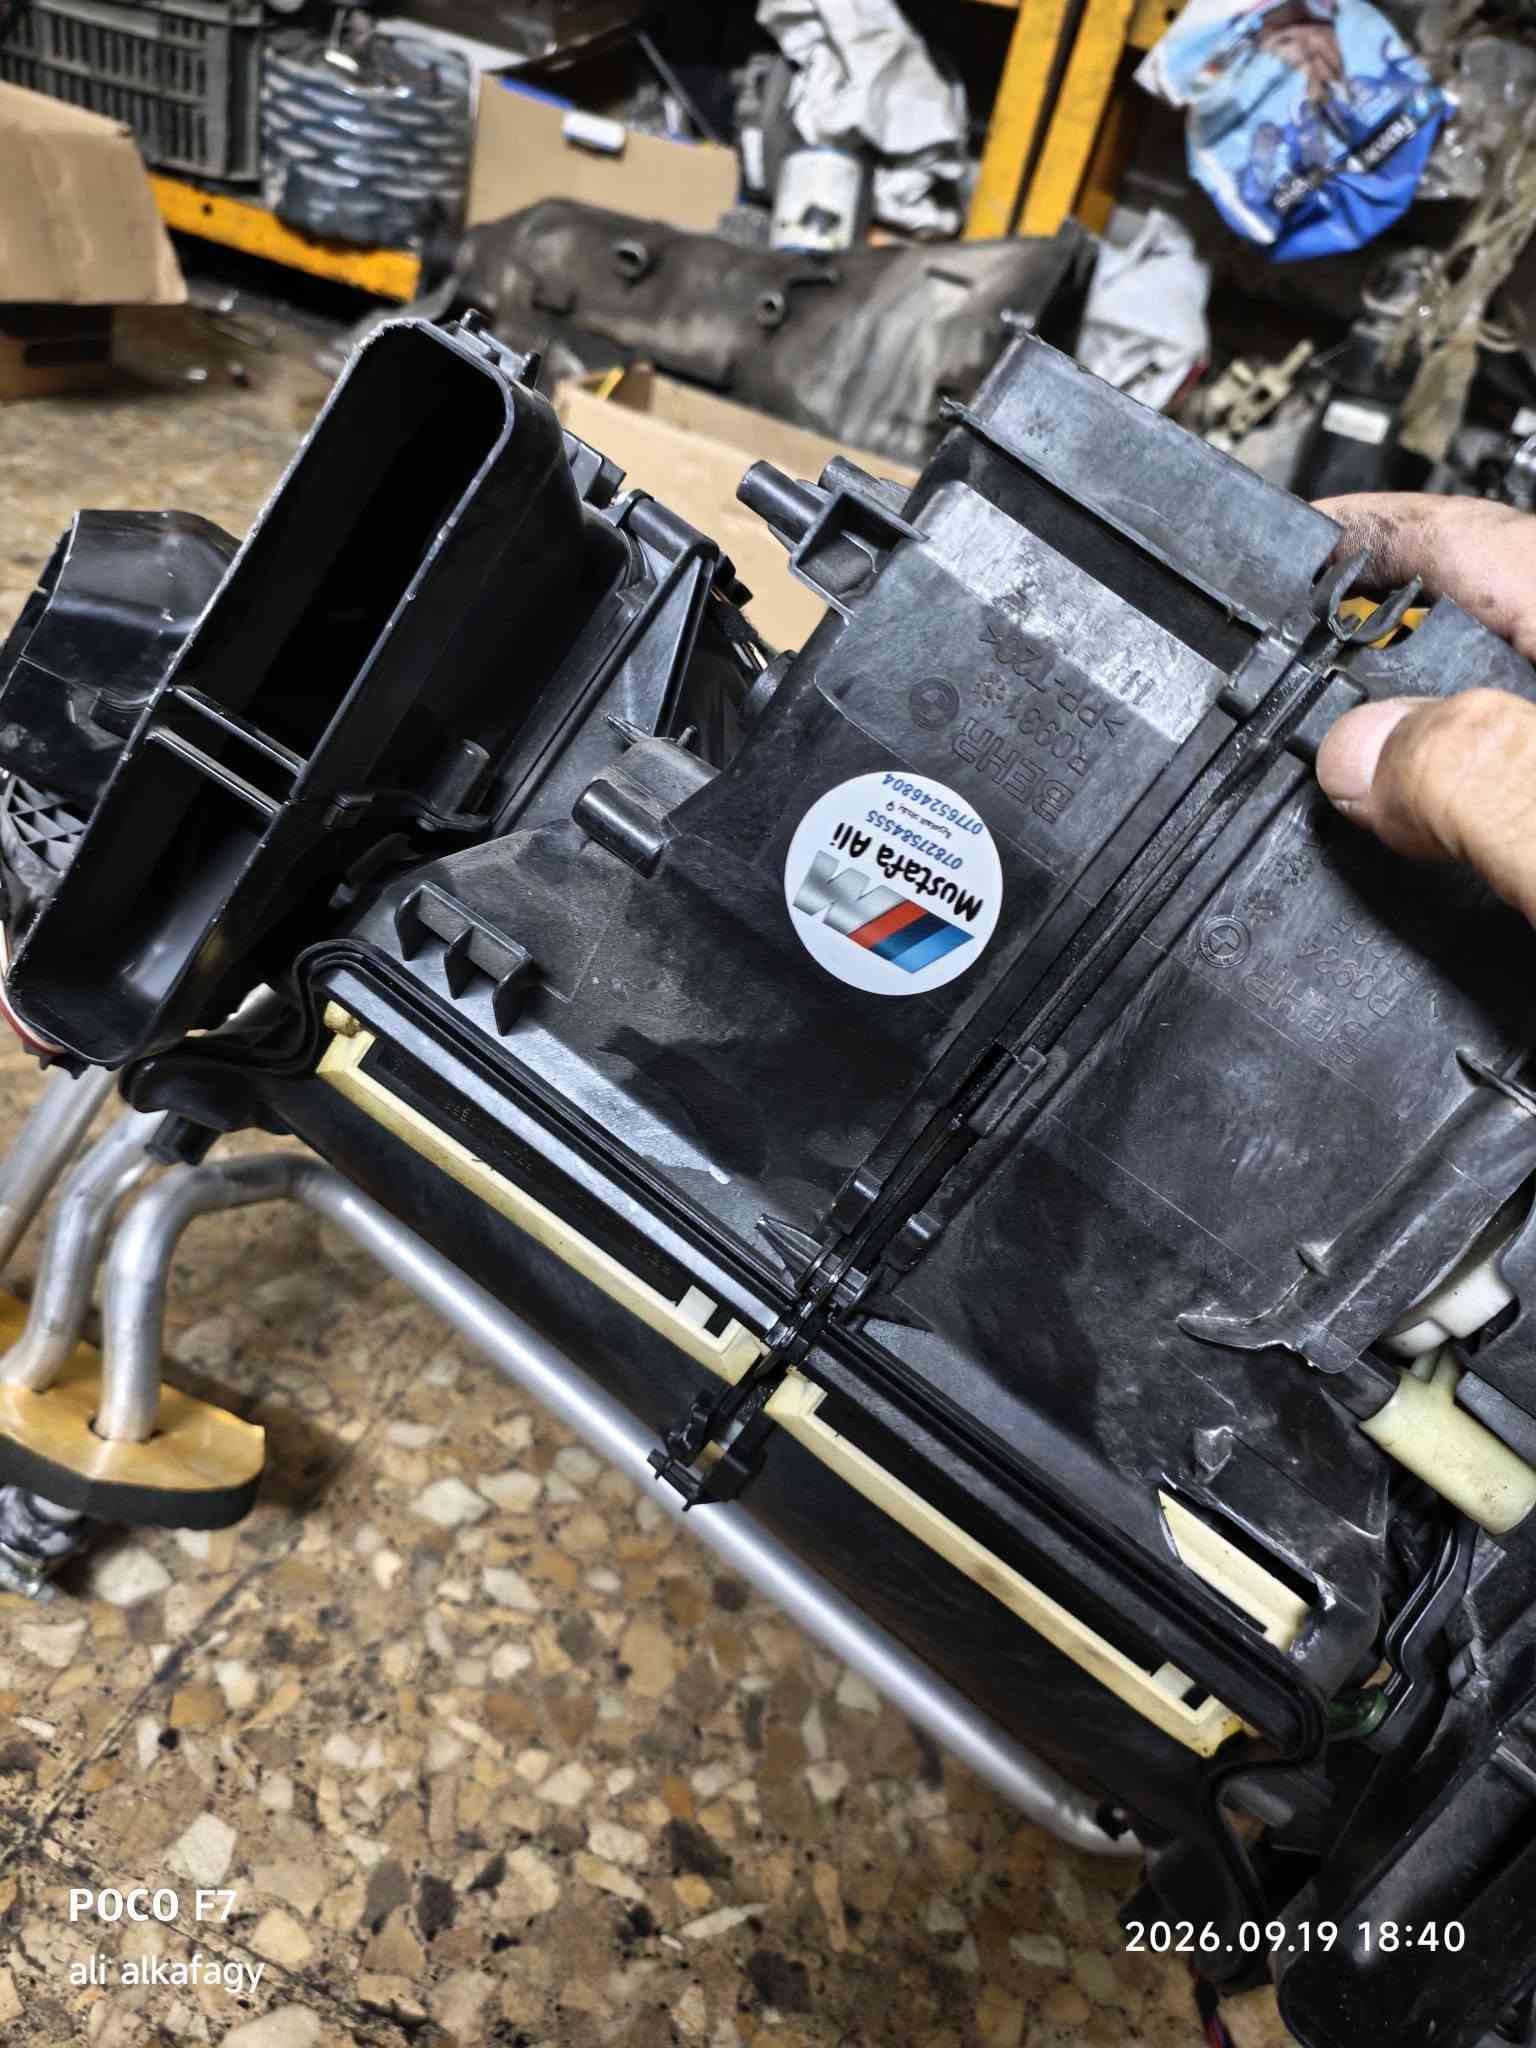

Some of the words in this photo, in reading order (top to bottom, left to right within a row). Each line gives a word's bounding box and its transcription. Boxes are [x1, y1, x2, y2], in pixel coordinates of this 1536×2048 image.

[951, 716, 1074, 825] BEHR
[882, 773, 984, 836] 07765246804
[830, 822, 873, 858] Ali
[865, 809, 963, 870] 07827584555
[877, 844, 983, 922] Mustafa
